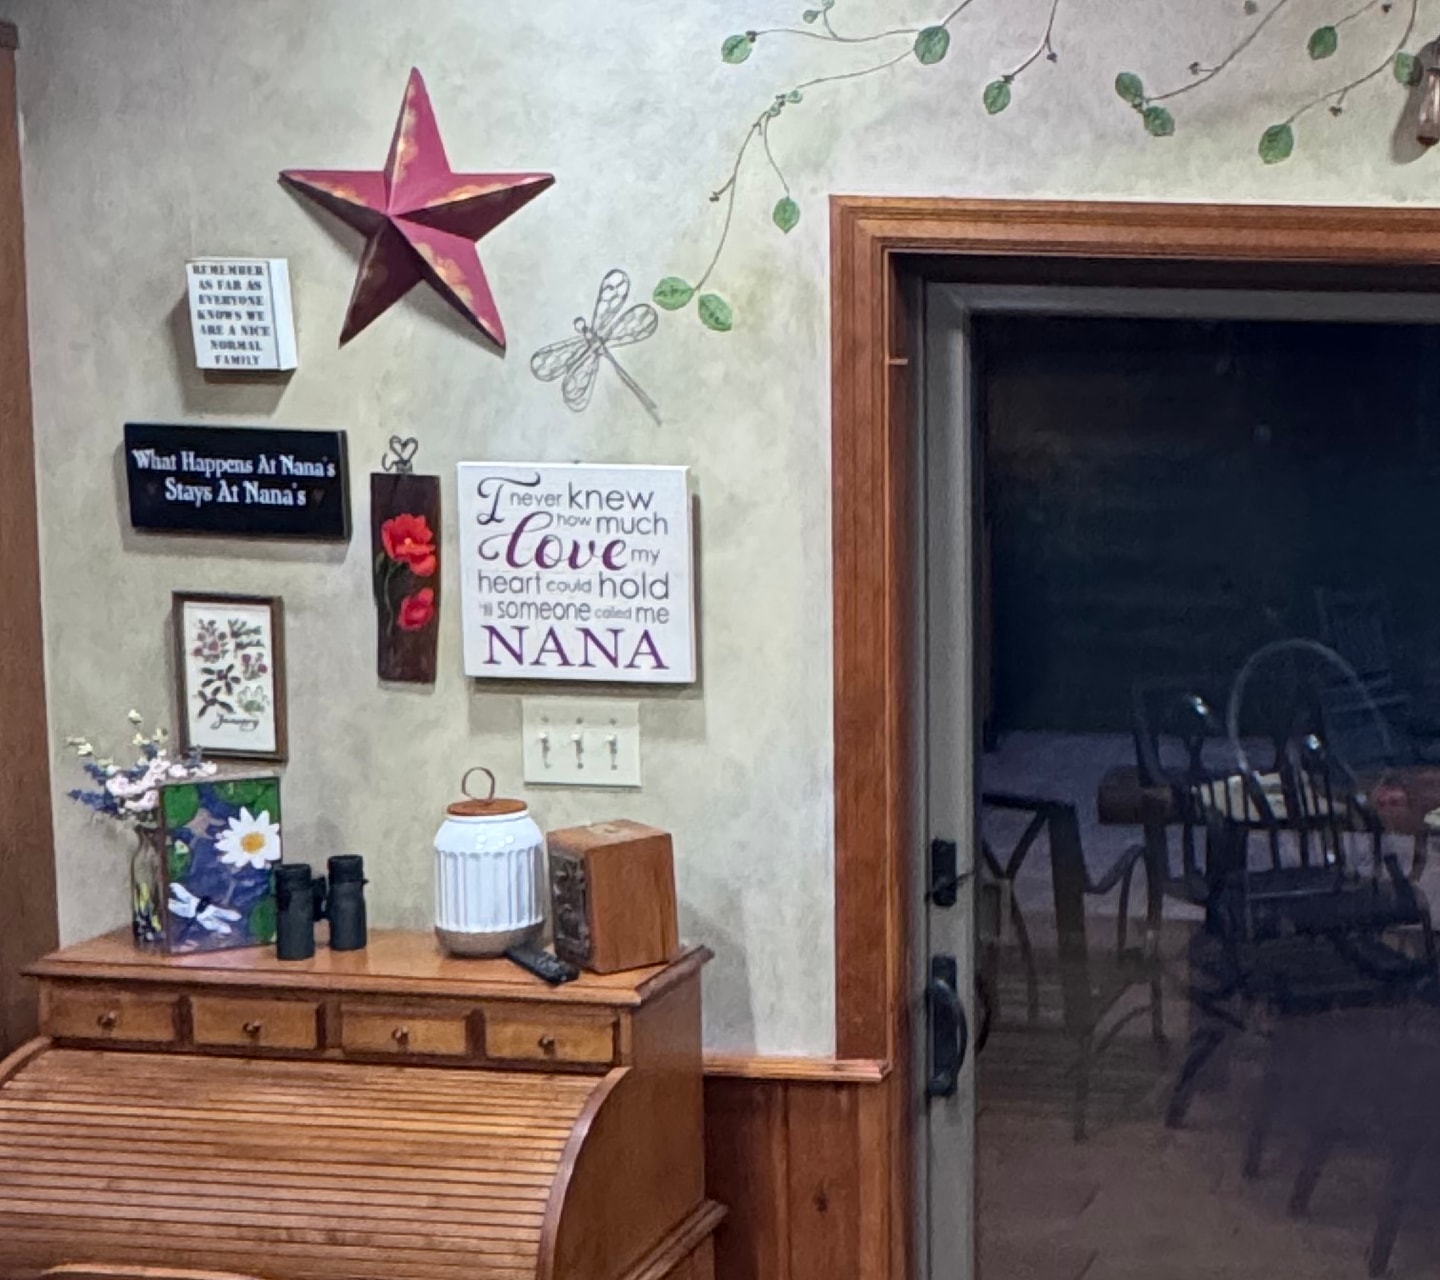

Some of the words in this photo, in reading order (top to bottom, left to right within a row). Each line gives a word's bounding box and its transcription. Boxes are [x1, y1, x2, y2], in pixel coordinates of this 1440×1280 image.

[192, 265, 264, 276] REMEMBER
[199, 280, 213, 291] AS
[217, 280, 242, 291] FAR
[247, 280, 263, 291] AS
[198, 294, 264, 306] EVERYONE
[197, 309, 242, 321] KNOWS
[246, 310, 265, 322] WE
[200, 324, 224, 336] ARE
[228, 324, 237, 336] A
[241, 325, 271, 337] NICE
[210, 340, 263, 351] NORMAL
[214, 354, 261, 366] FAMILY
[131, 448, 177, 471] What
[180, 450, 254, 479] Happens
[257, 454, 276, 475] At
[279, 455, 336, 478] Nana's
[164, 477, 213, 508] Stays
[216, 480, 240, 503] At
[242, 481, 307, 506] Nana's
[509, 491, 563, 507] never
[567, 481, 655, 511] knew
[556, 513, 592, 527] how
[596, 511, 669, 536] much
[630, 548, 661, 566] my
[478, 570, 541, 595] heart
[546, 579, 592, 594] could
[599, 571, 670, 600] hold
[497, 601, 591, 621] someone
[594, 606, 632, 619] called
[635, 606, 670, 625] me
[481, 624, 670, 670] NANA
